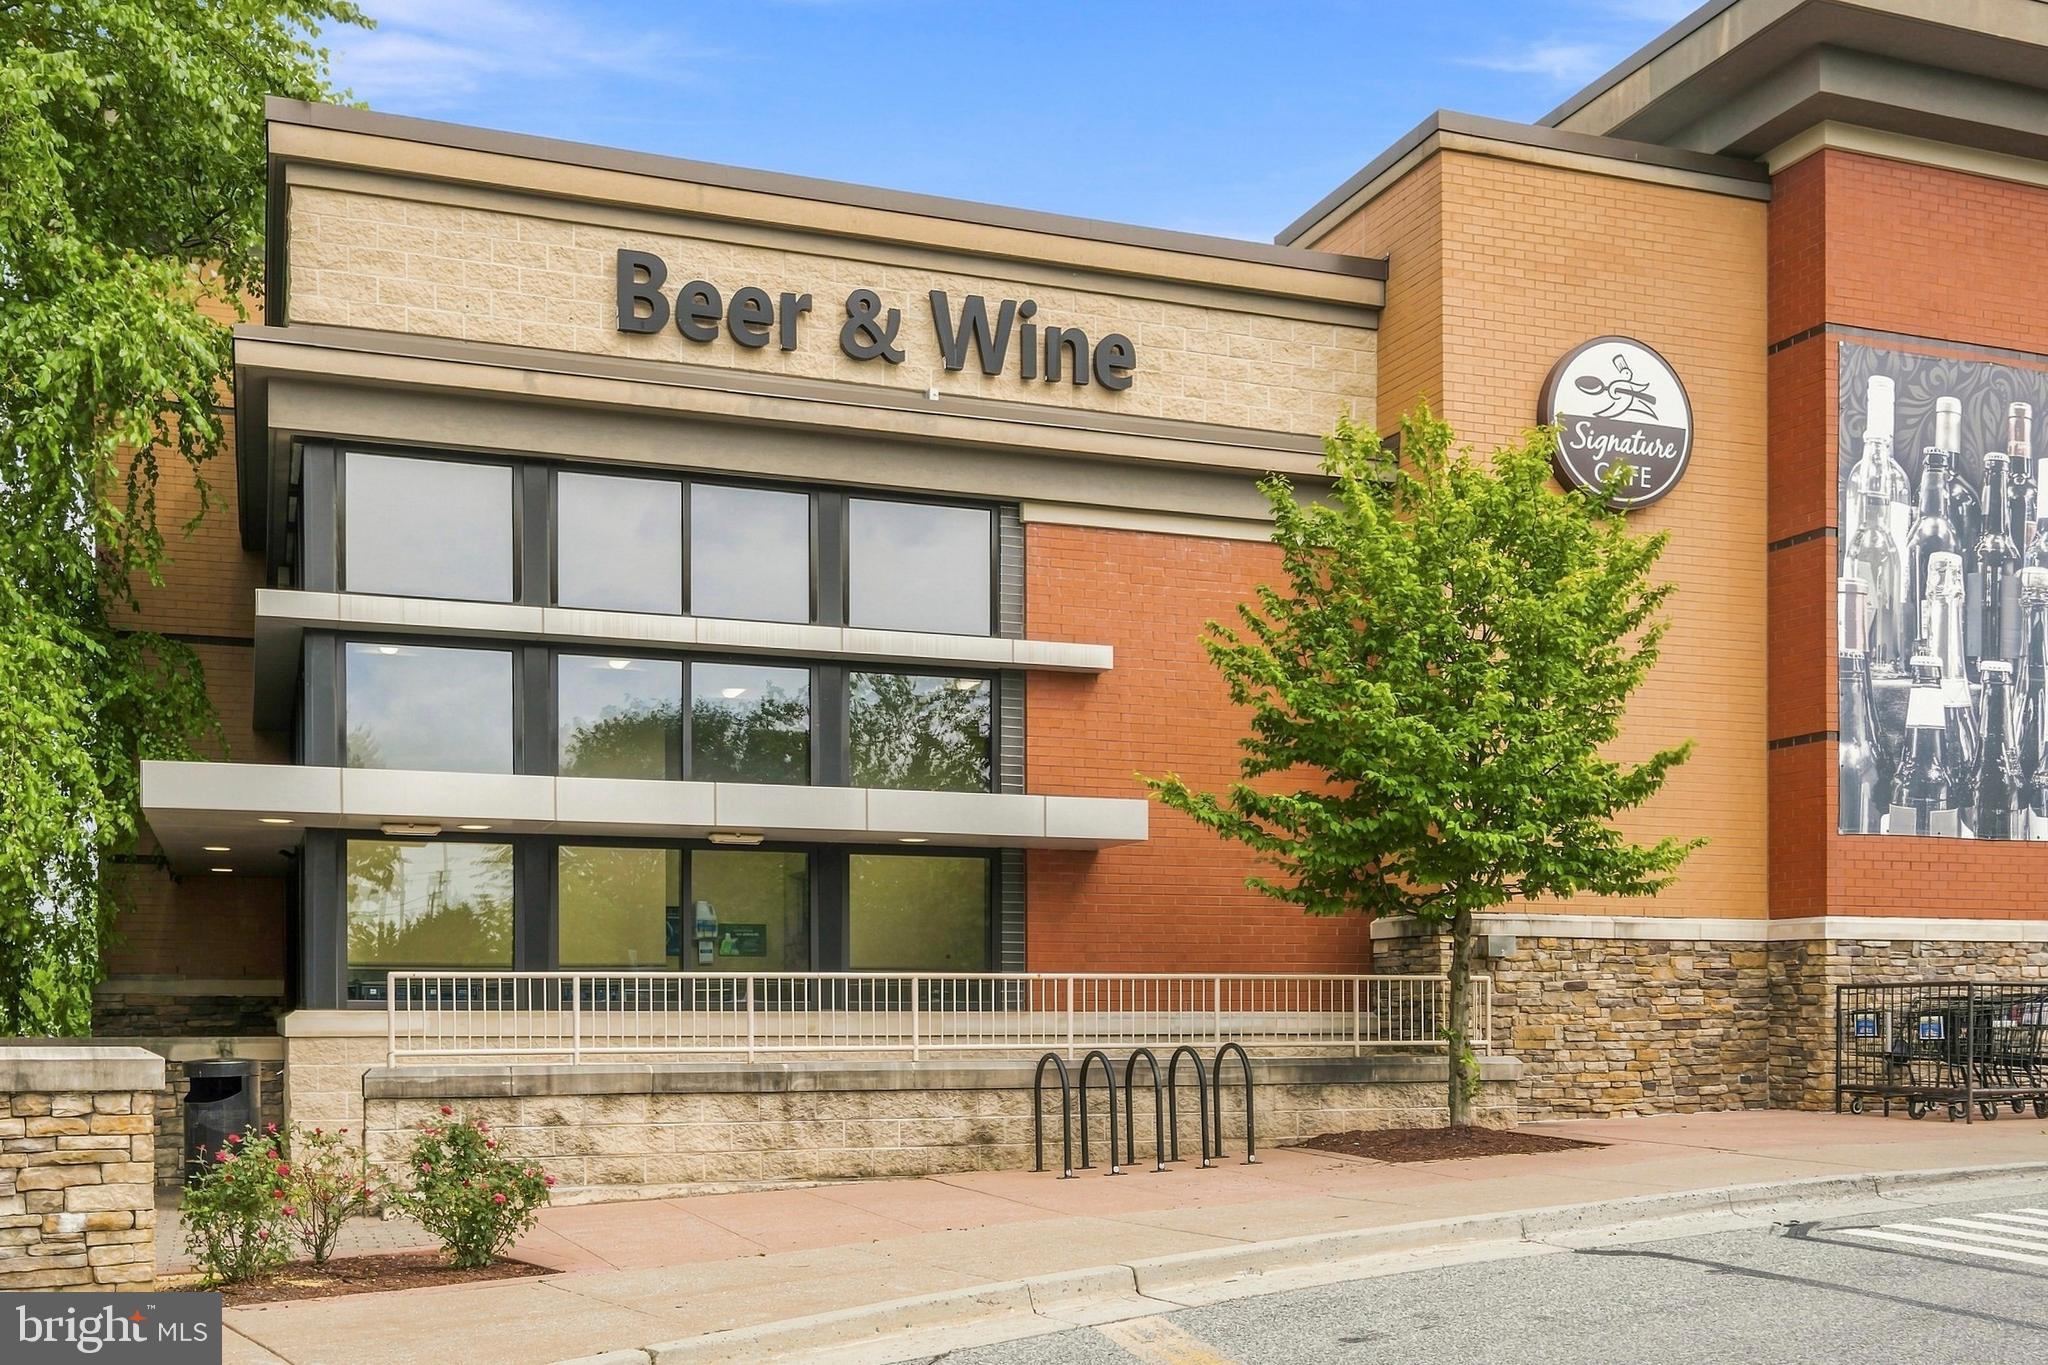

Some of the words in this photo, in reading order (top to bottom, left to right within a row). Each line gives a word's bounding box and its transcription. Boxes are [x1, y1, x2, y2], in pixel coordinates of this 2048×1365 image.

[616, 248, 813, 351] Beer
[839, 288, 906, 365] &
[928, 288, 1137, 391] Wine
[1570, 421, 1677, 460] Signature
